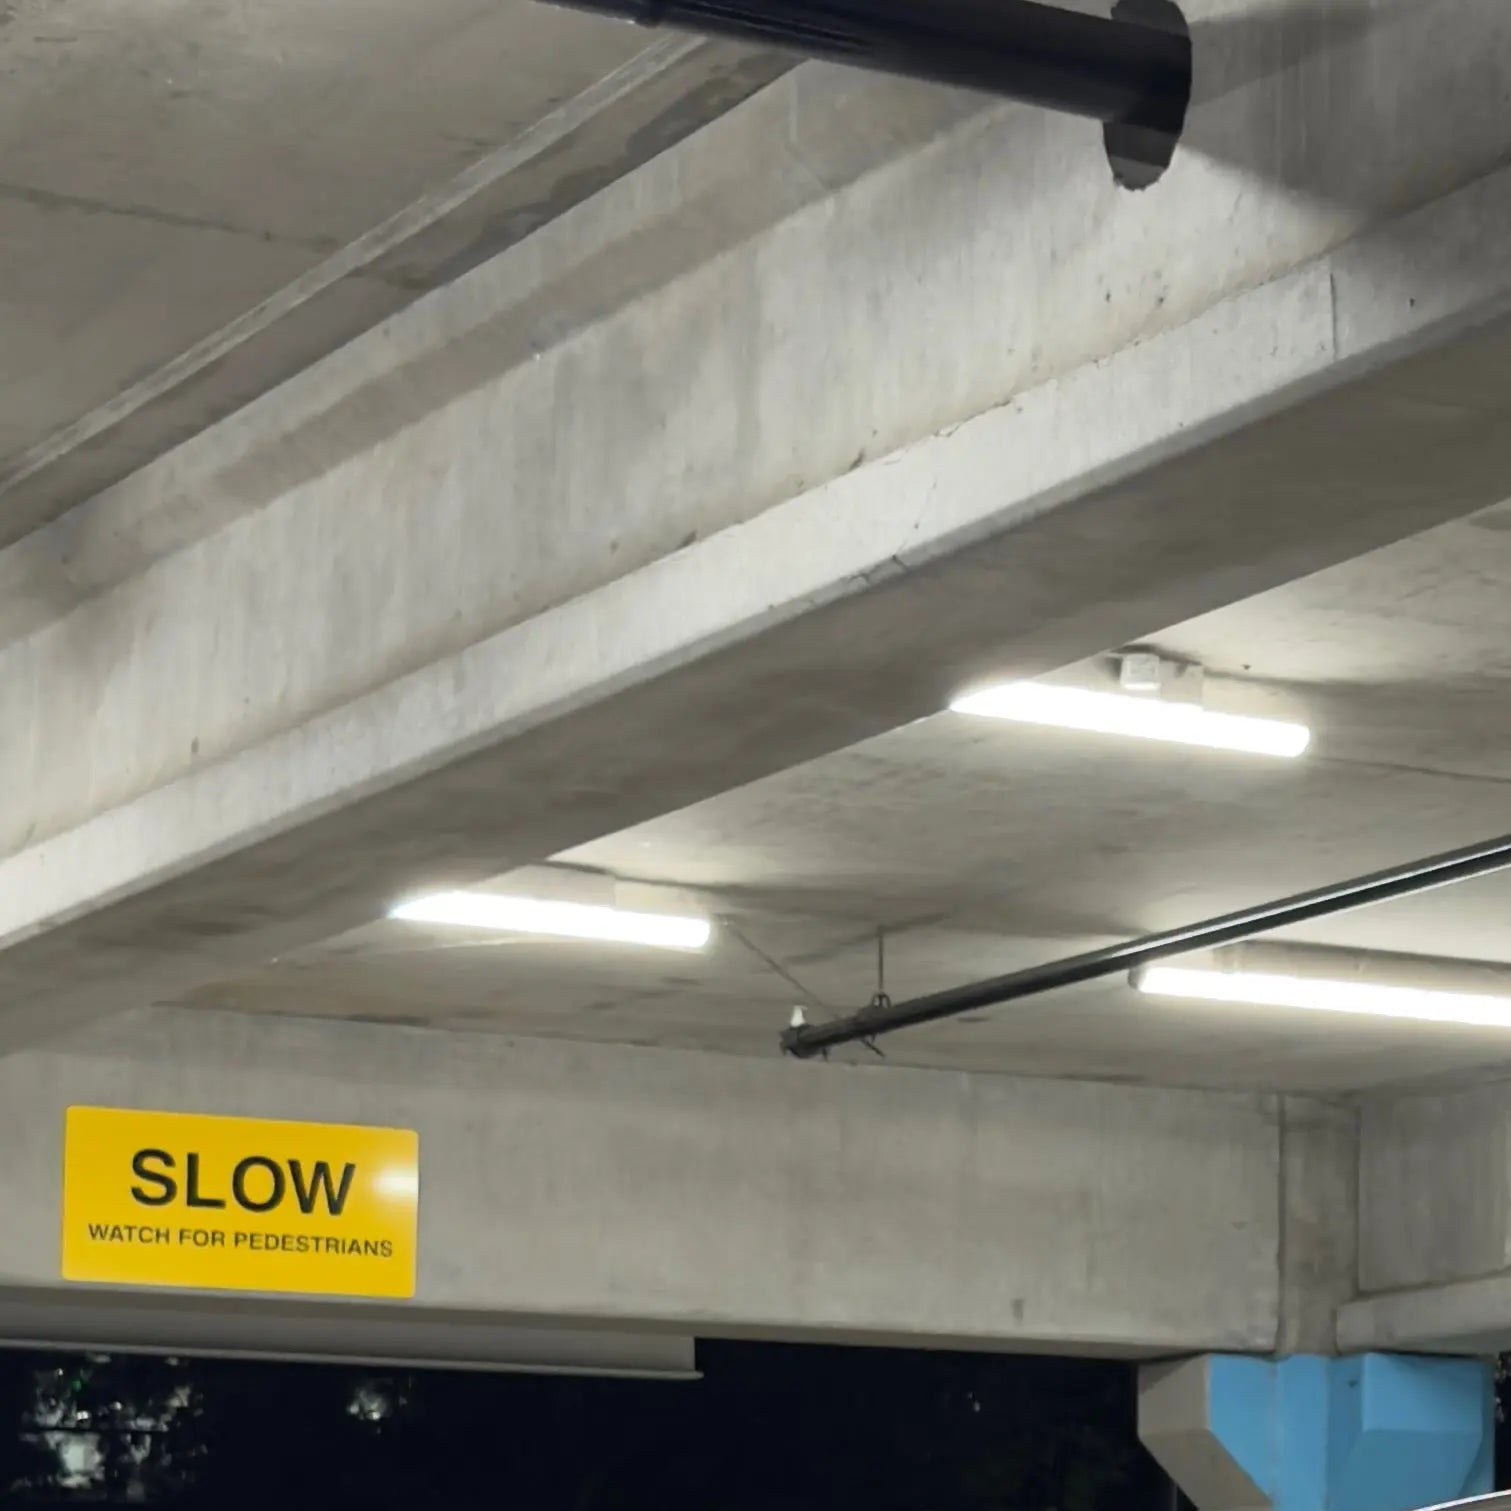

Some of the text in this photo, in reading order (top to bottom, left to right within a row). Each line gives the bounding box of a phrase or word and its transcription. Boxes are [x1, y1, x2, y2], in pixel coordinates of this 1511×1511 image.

[130, 1148, 356, 1216] SLOW
[88, 1223, 393, 1258] WATCH FOR PEDESTRIANS
